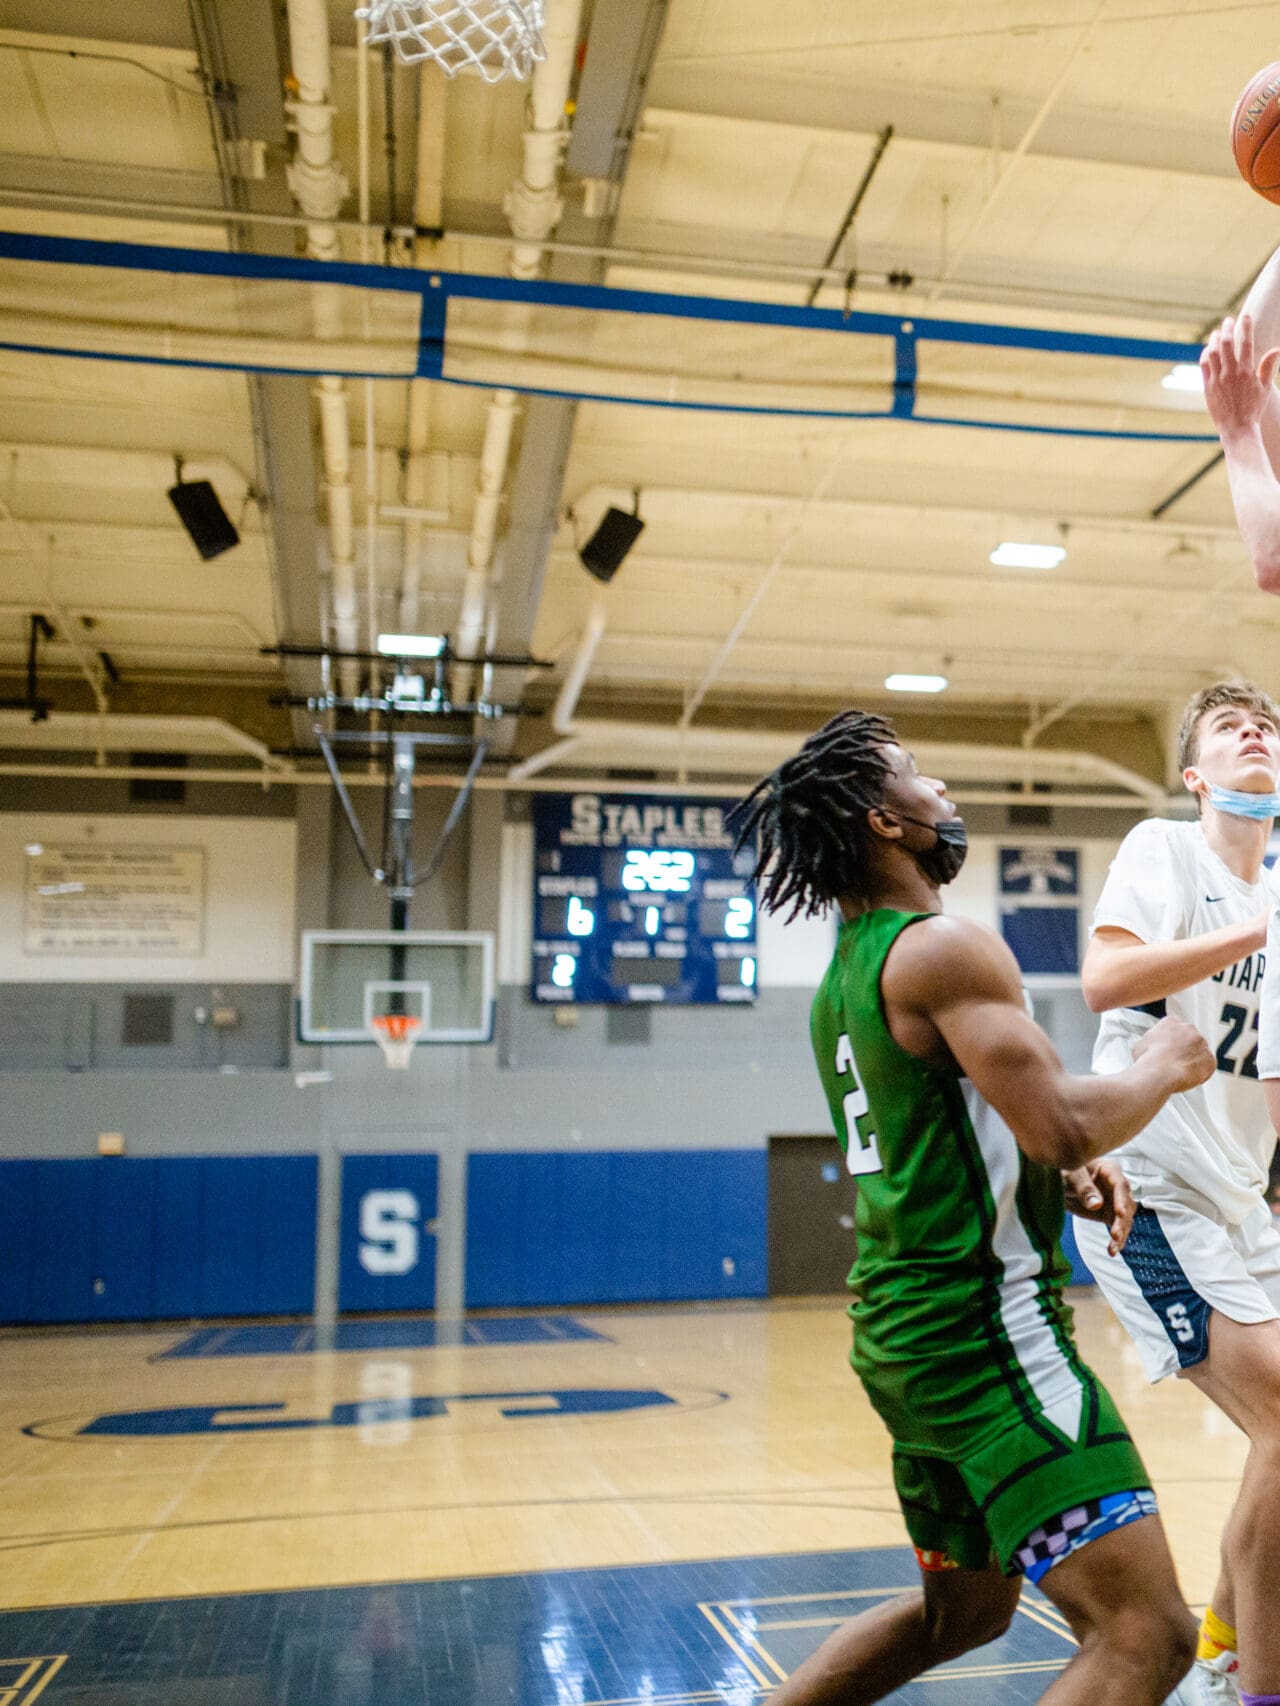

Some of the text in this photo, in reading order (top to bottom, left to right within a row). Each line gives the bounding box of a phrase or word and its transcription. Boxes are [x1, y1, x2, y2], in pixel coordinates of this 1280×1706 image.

[571, 793, 725, 834] STAPLES
[835, 1032, 884, 1177] 2
[359, 1188, 420, 1276] S
[1165, 1302, 1195, 1343] S
